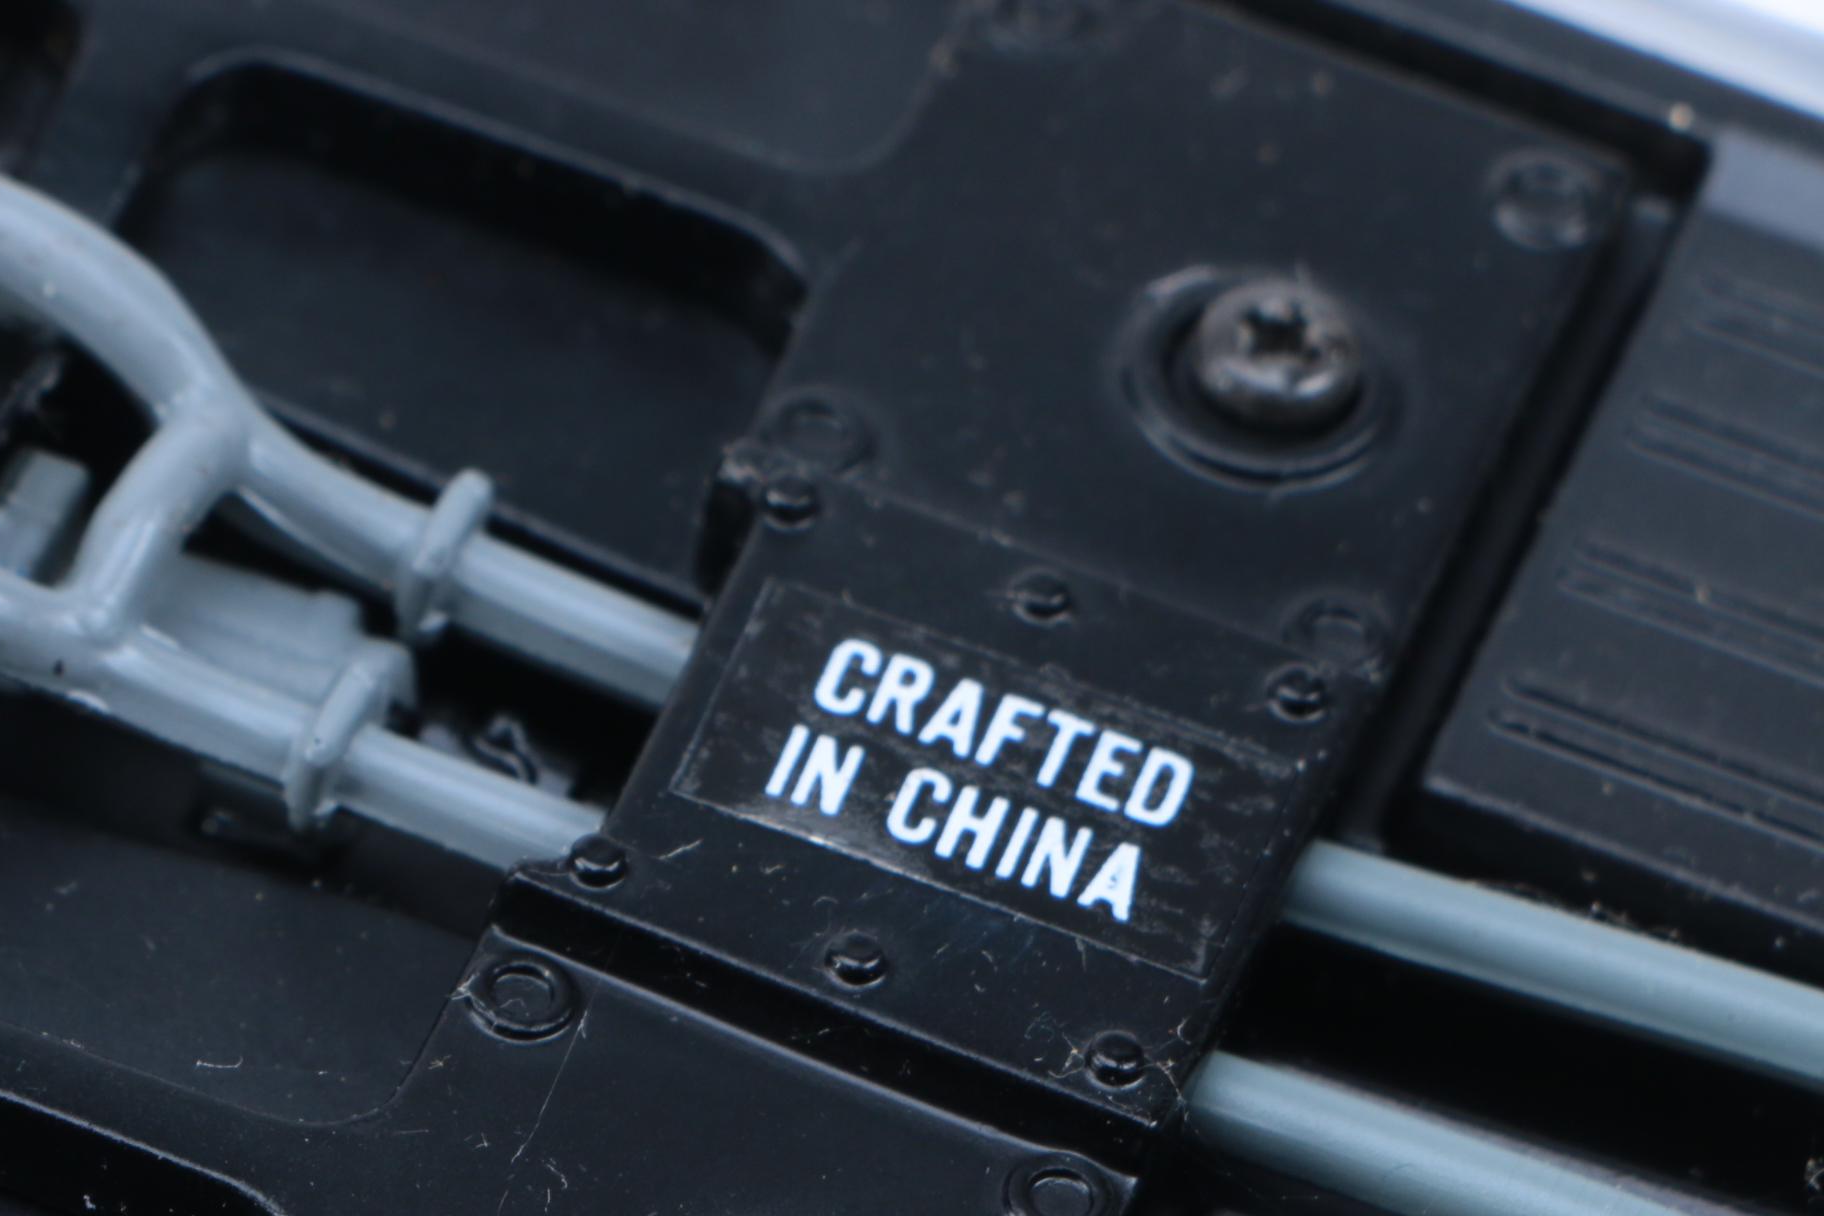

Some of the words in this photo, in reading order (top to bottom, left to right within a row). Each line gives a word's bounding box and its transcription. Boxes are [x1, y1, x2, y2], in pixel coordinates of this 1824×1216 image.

[765, 725, 865, 816] IN
[886, 769, 1142, 921] CHINA
[814, 639, 1193, 827] CRAFTED
